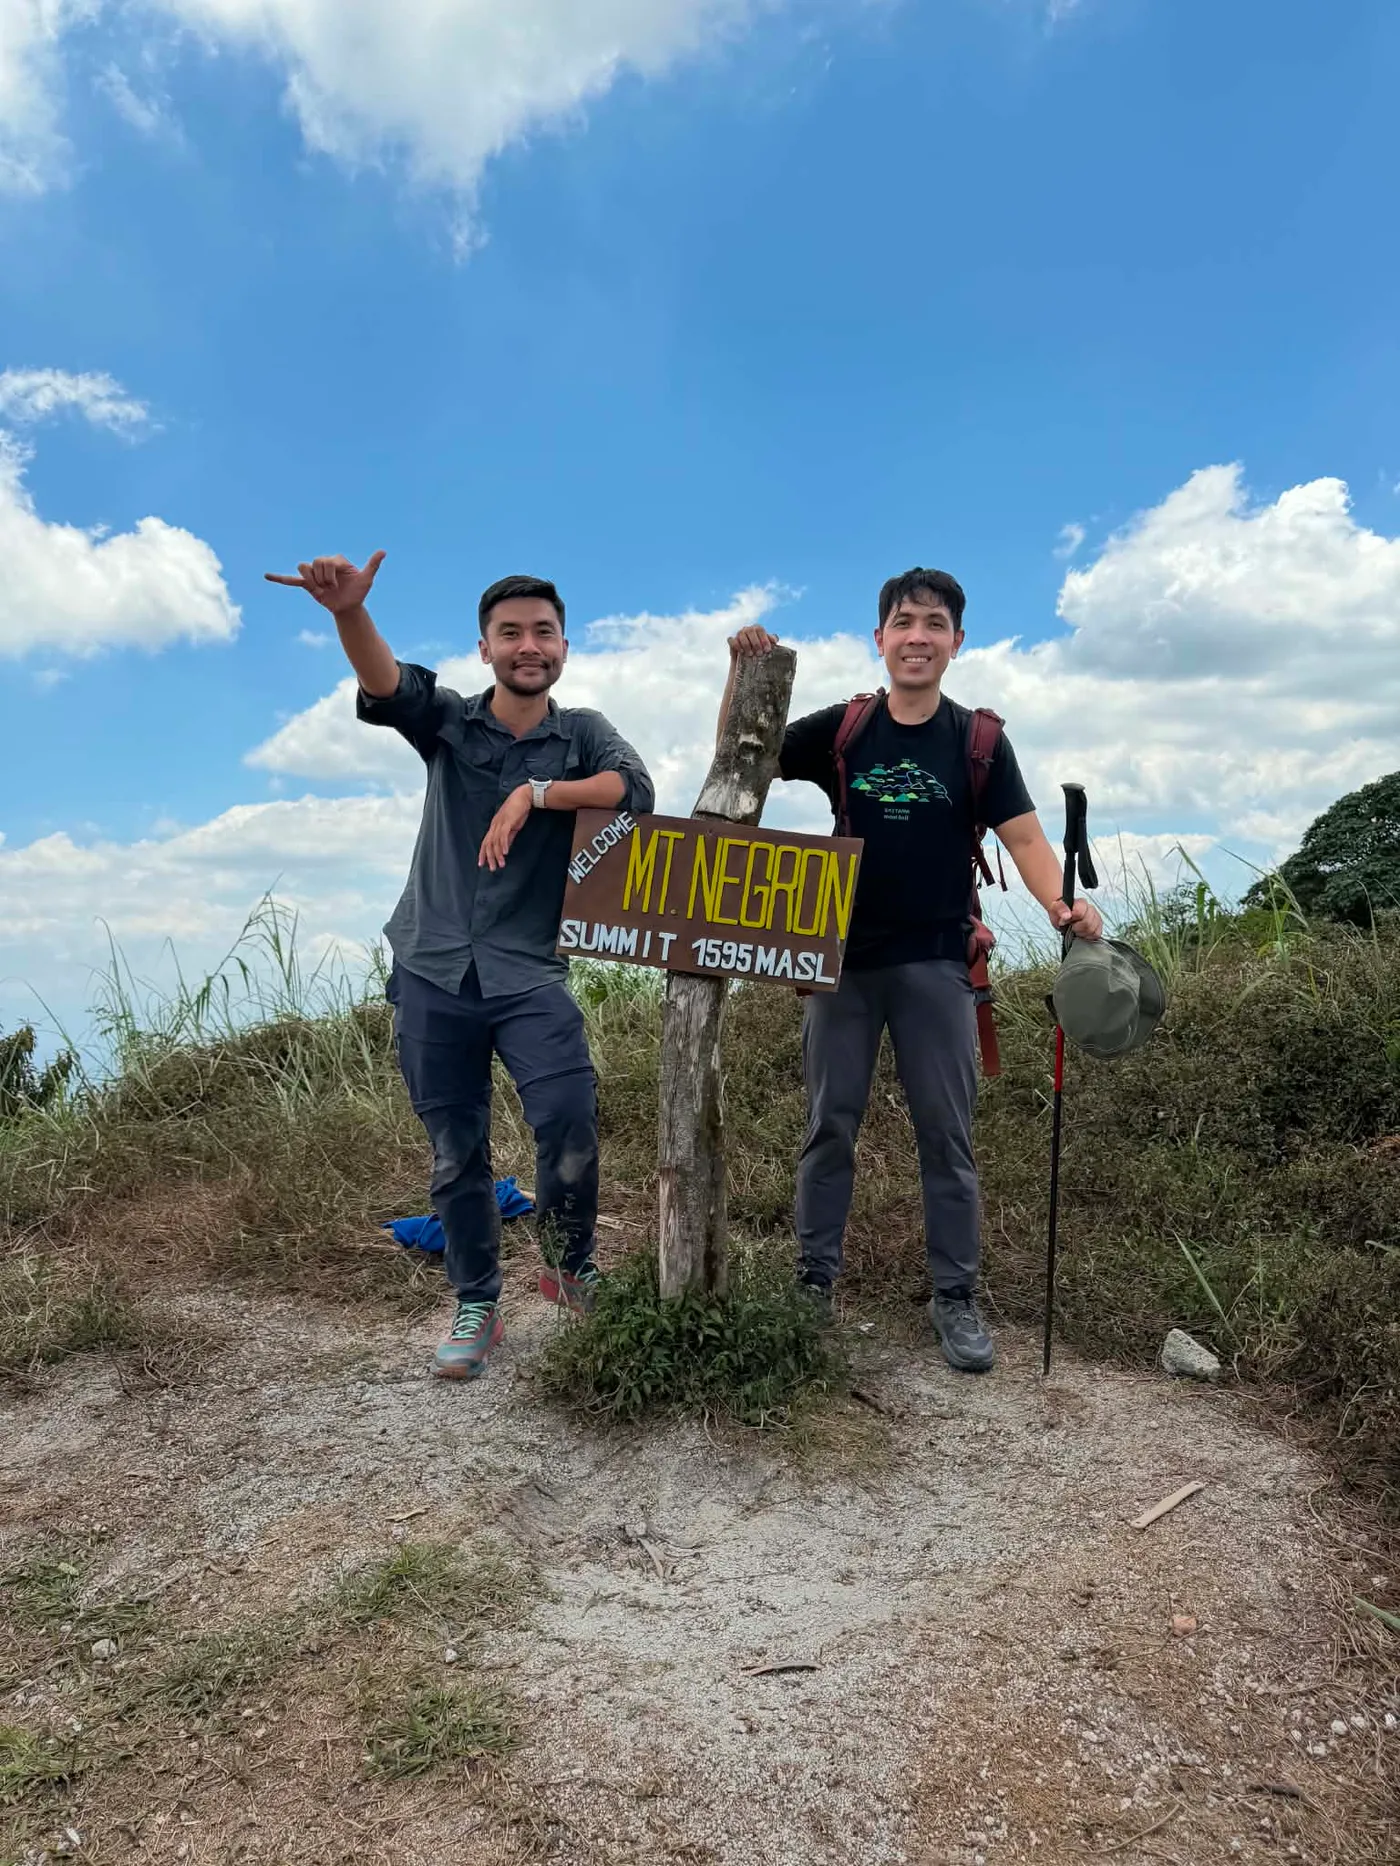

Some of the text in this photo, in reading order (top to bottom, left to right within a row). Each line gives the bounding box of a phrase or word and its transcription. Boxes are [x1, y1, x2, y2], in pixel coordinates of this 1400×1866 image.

[568, 811, 637, 883] WELCOME
[622, 826, 857, 940] MT. NEGRON
[559, 919, 677, 961] SUMMIT
